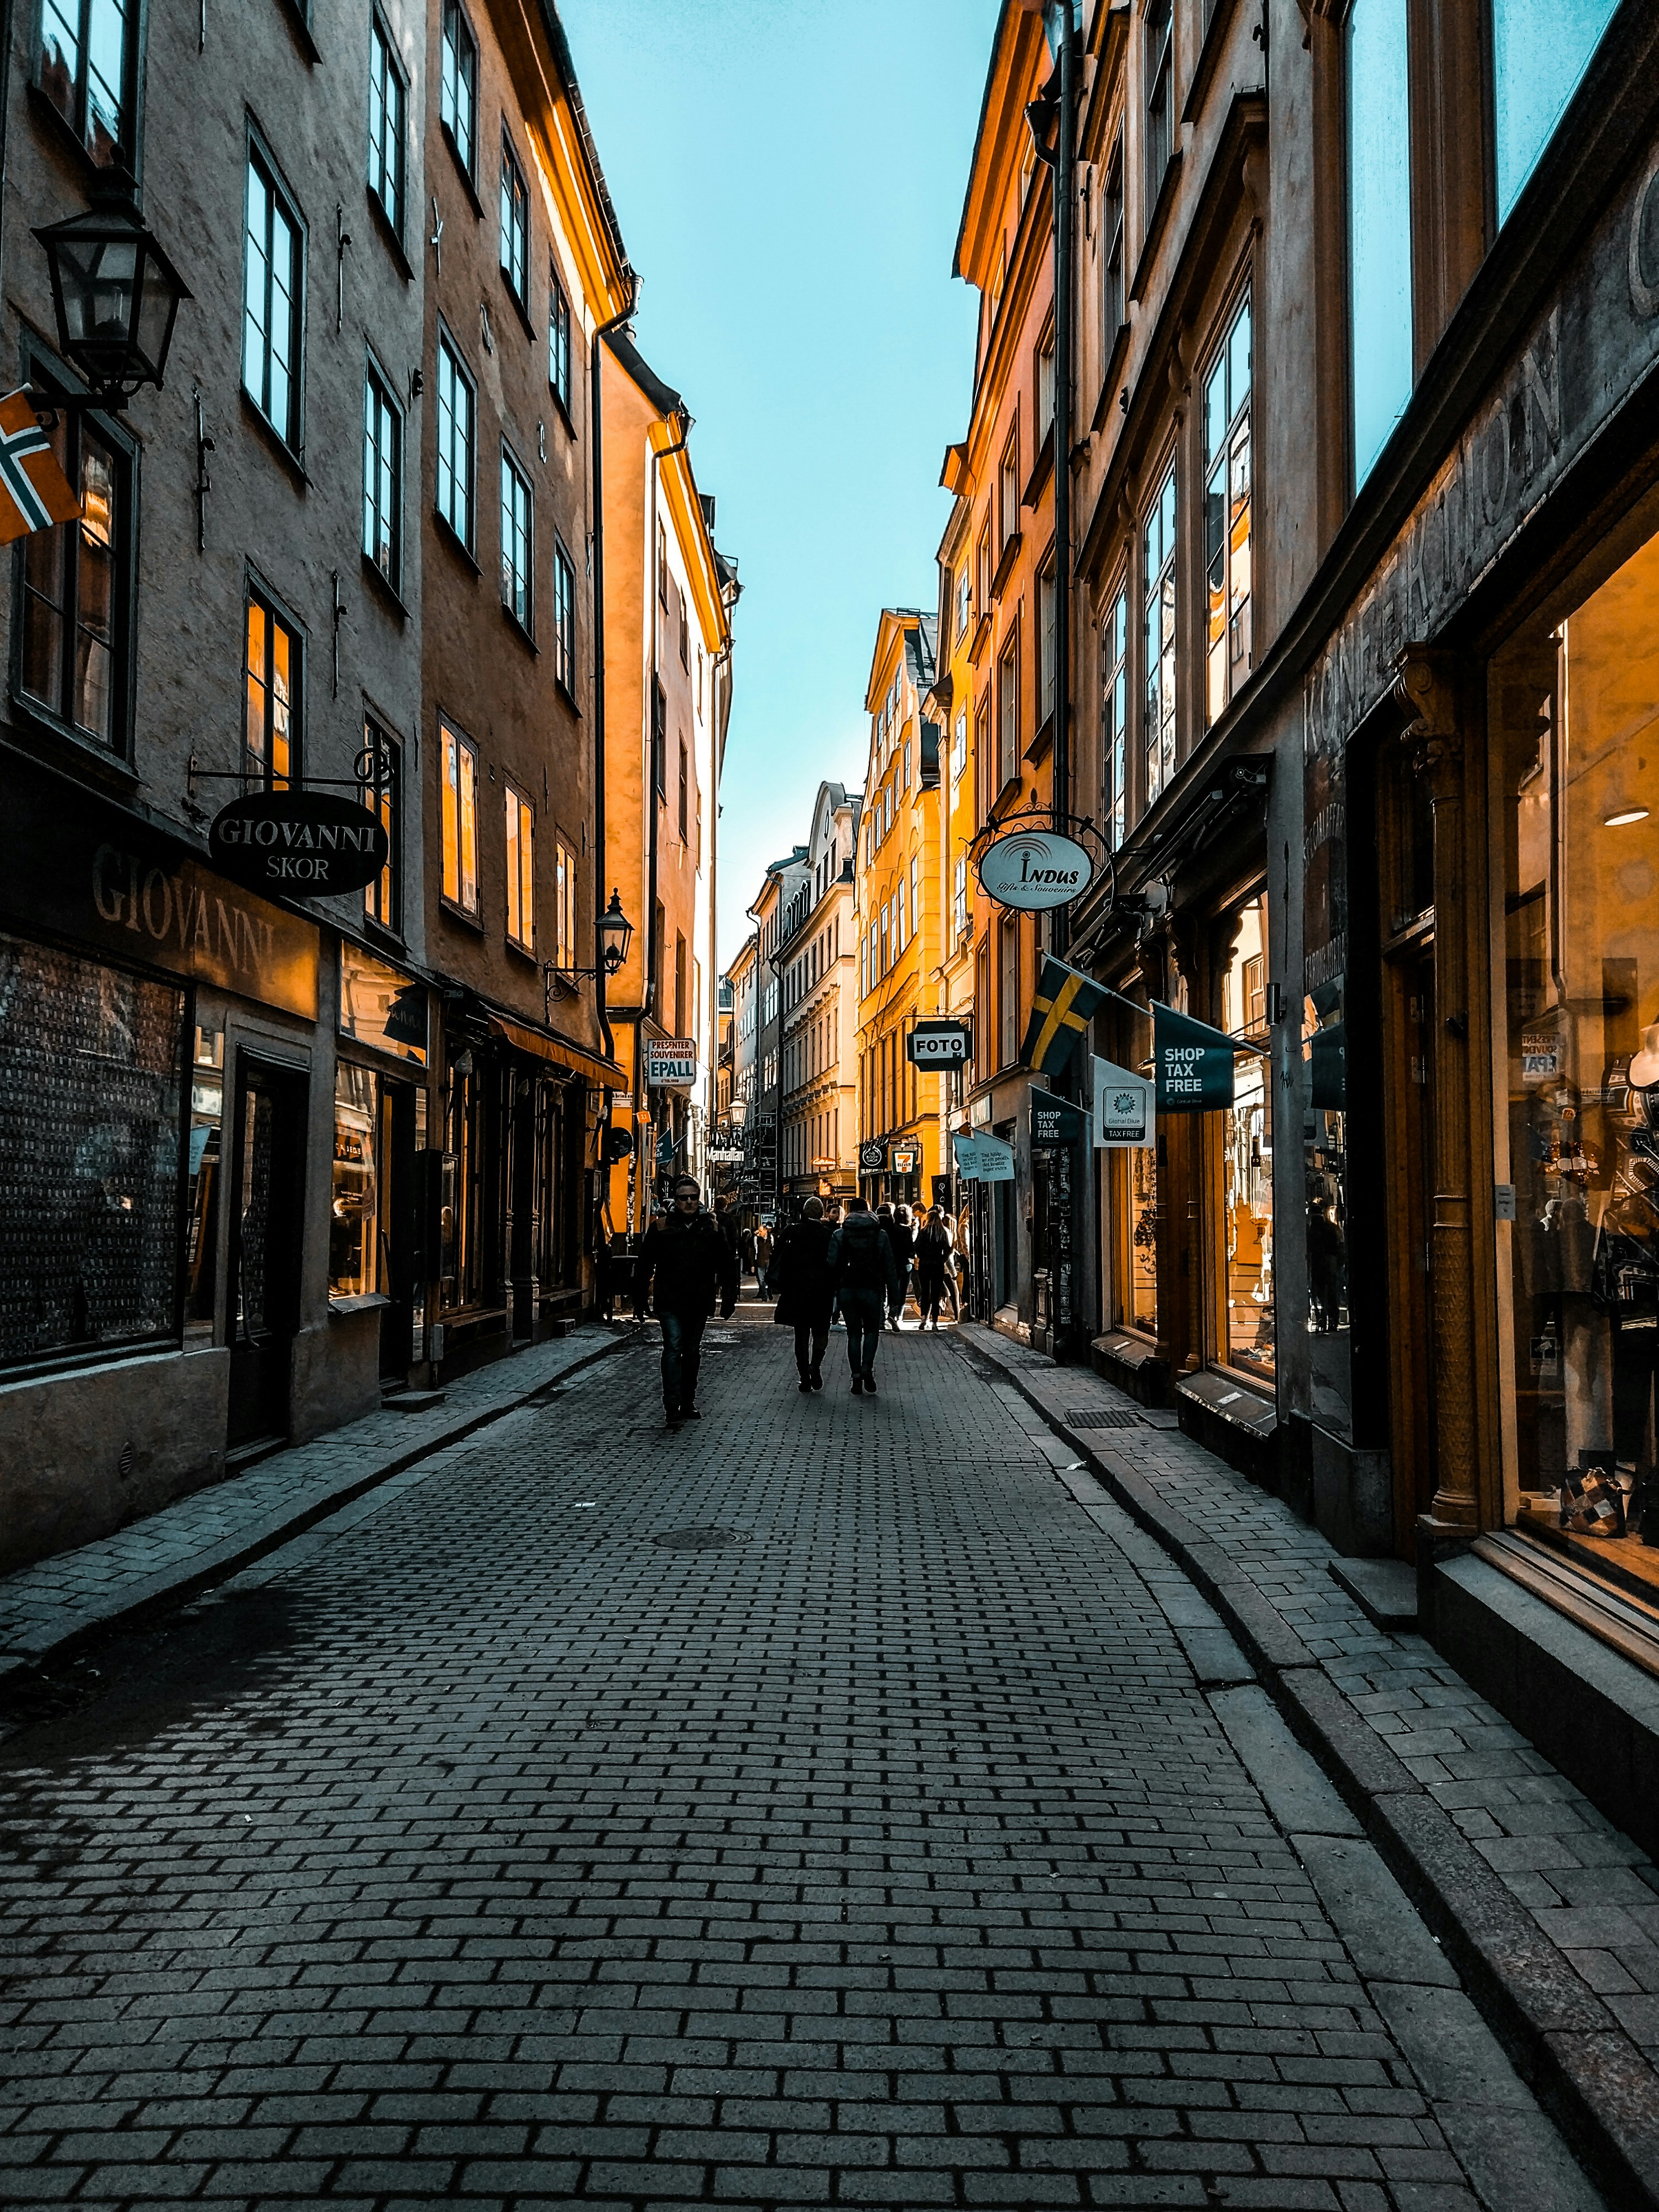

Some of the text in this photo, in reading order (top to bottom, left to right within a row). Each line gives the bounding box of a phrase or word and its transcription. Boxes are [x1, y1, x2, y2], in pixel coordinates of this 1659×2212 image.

[218, 819, 377, 852] GIOVANNI
[266, 856, 329, 880] SKOR
[997, 883, 1018, 893] Gifts
[1030, 884, 1076, 893] Souvenirs
[92, 844, 275, 985] GIOVANNI
[652, 1041, 690, 1049] PRESENTER
[916, 1039, 962, 1053] FOTO
[1165, 1047, 1205, 1061] SHOP
[651, 1061, 693, 1077] EPALL
[1165, 1063, 1194, 1076] TAX
[1166, 1078, 1202, 1092] FREE
[707, 1146, 744, 1161] Manhattan
[898, 1155, 911, 1172] 7
